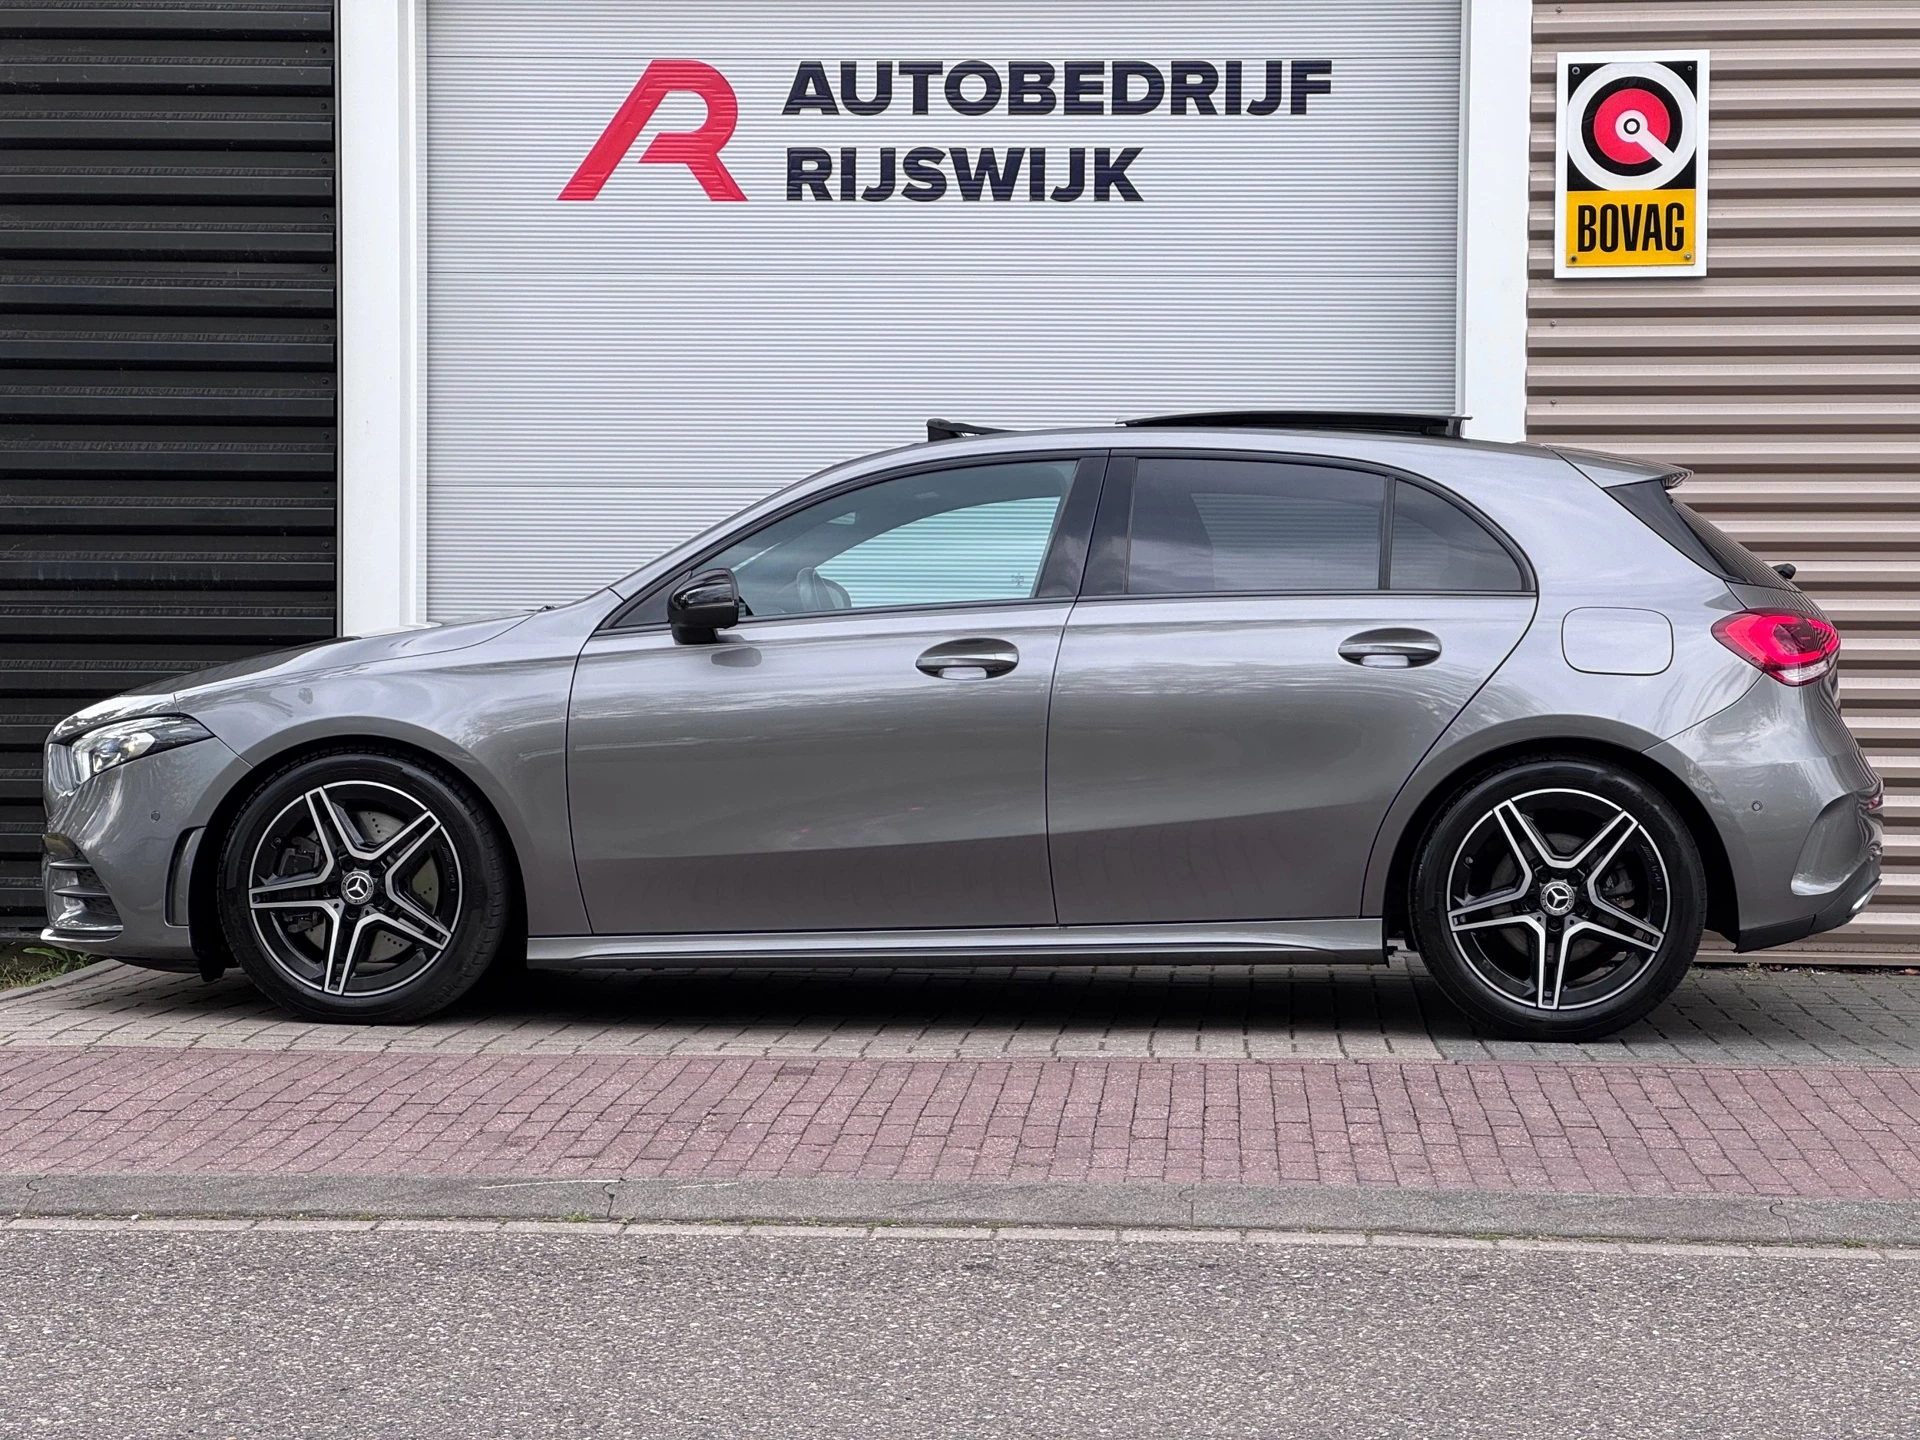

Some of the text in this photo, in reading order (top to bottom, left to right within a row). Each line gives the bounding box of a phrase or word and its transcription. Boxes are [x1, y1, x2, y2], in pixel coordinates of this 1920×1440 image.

[783, 60, 1332, 115] AUTOBEDRIJF
[787, 147, 1144, 202] RIJSWIJK
[1577, 202, 1685, 253] BOVAG
